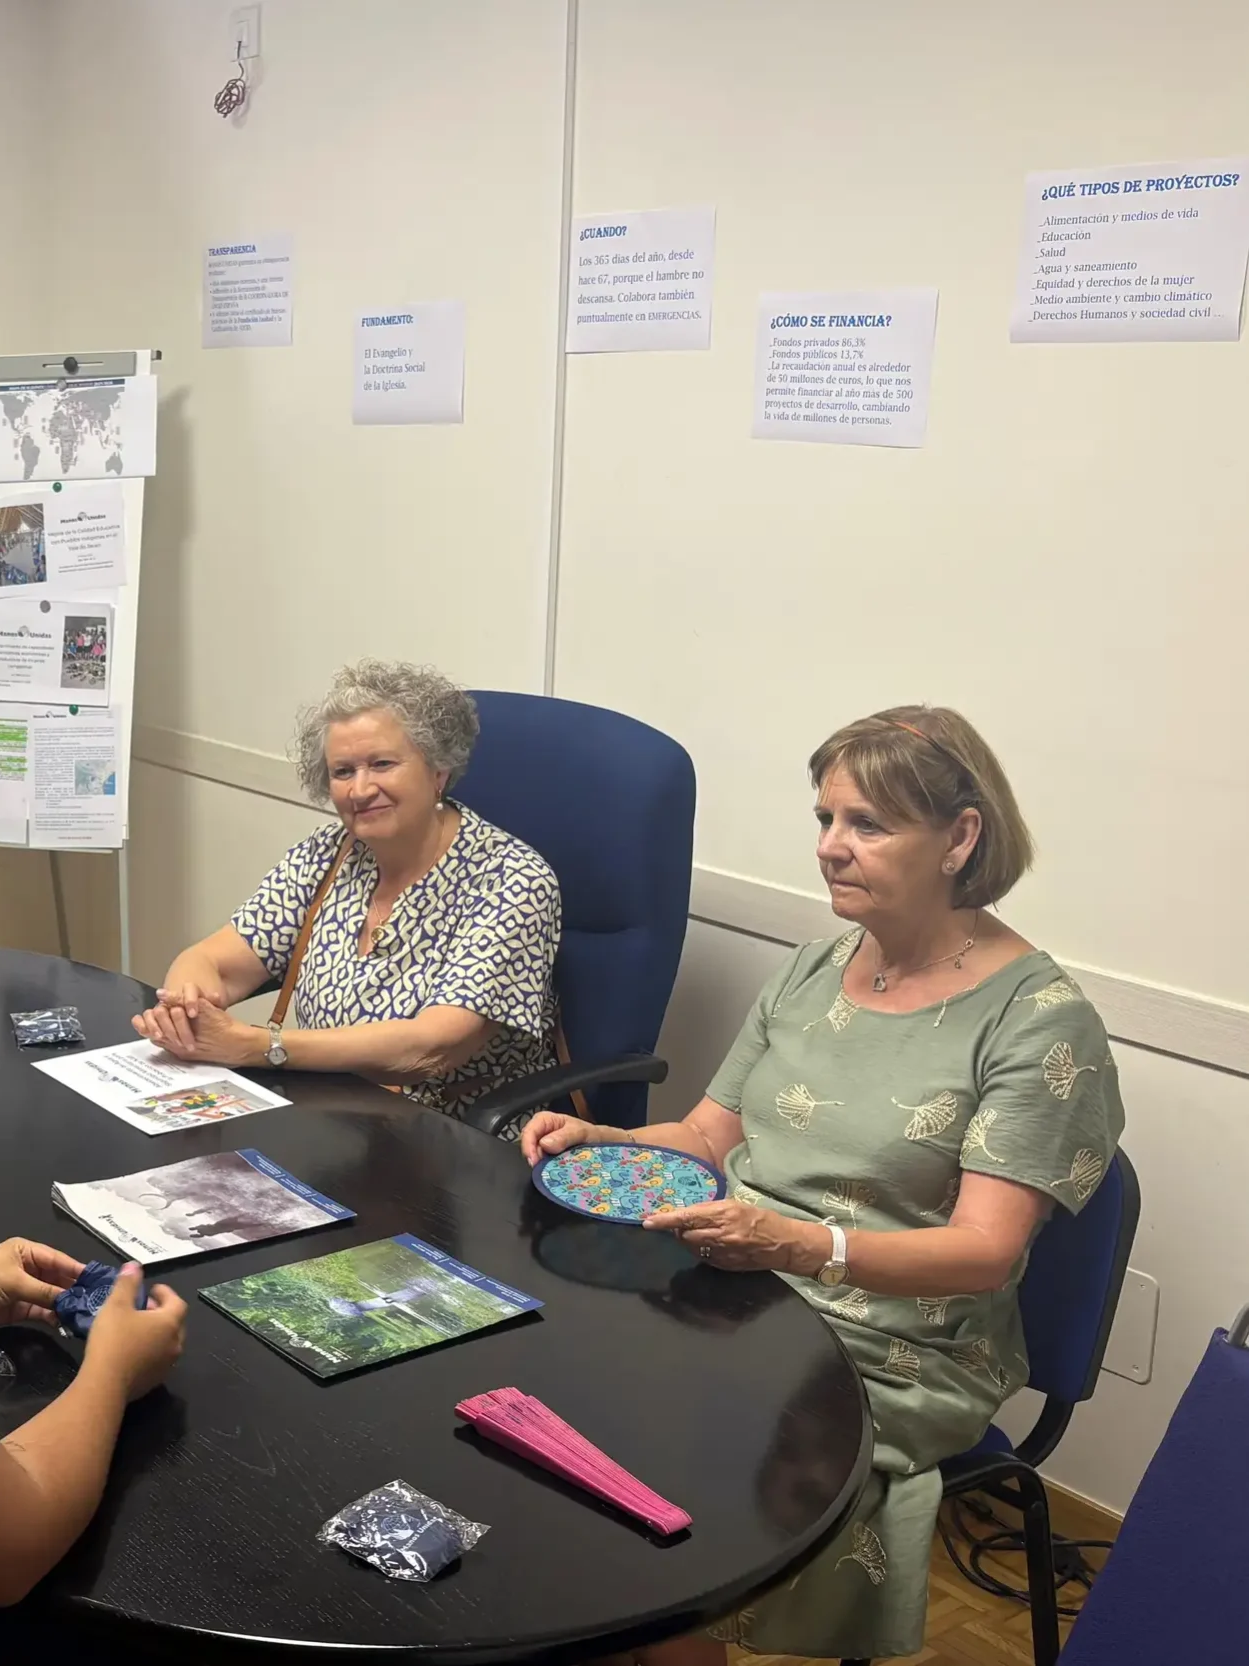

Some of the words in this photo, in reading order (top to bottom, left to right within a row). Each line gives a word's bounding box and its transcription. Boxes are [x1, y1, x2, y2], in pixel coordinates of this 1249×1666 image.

[1041, 182, 1076, 201] ¿QUÉ
[1079, 181, 1120, 196] TIPOS
[1123, 180, 1142, 193] DE
[1145, 174, 1240, 192] PROYECTOS?
[1112, 214, 1119, 224] y
[1121, 210, 1158, 222] medios
[1161, 209, 1174, 220] de
[1177, 207, 1199, 219] vida
[579, 225, 627, 241] ¿CUANDO?
[579, 256, 592, 267] Los
[594, 255, 609, 266] 365
[632, 252, 646, 263] del
[648, 252, 666, 262] año,
[668, 249, 694, 261] desde
[1065, 265, 1071, 274] y
[1073, 261, 1137, 272] saneamiento
[578, 275, 596, 286] hace
[613, 273, 644, 286] porque
[646, 271, 654, 282] el
[656, 269, 690, 281] hambre
[692, 270, 704, 280] no
[1078, 280, 1084, 290] y
[1086, 276, 1132, 287] derechos
[1135, 276, 1148, 285] de
[1150, 275, 1159, 285] la
[1163, 274, 1195, 287] mujer
[577, 293, 615, 305] descansa.
[618, 292, 656, 303] Colabora
[1066, 293, 1112, 304] ambiente
[1115, 295, 1121, 305] y
[1123, 292, 1161, 303] cambio
[577, 312, 633, 325] puntualmente
[635, 313, 646, 321] en
[1080, 309, 1128, 319] Humanos
[1131, 310, 1138, 320] y
[1140, 307, 1186, 318] sociedad
[1189, 307, 1211, 318] civil
[361, 314, 414, 327] FUNDAMENTO:
[770, 313, 808, 329] ¿CÓMO
[810, 315, 826, 327] SE
[828, 315, 892, 327] FINANCIA?
[804, 337, 839, 348] privados
[364, 349, 371, 359] El
[373, 347, 406, 359] Evangelio
[364, 364, 370, 375] la
[372, 364, 403, 375] Doctrina
[405, 361, 426, 373] Social
[832, 362, 856, 372] anual
[857, 364, 867, 372] es
[869, 362, 911, 372] alrededor
[363, 381, 372, 391] de
[373, 380, 380, 391] la
[766, 373, 776, 383] de
[778, 374, 788, 383] 50
[790, 374, 824, 384] millones
[826, 375, 836, 384] de
[838, 377, 863, 386] euros,
[866, 375, 874, 385] lo
[876, 378, 892, 387] que
[895, 378, 911, 386] nos
[766, 388, 796, 397] permite
[798, 387, 833, 397] financiar
[835, 388, 843, 397] al
[845, 389, 860, 397] año
[883, 389, 893, 399] de
[896, 390, 913, 399] 500
[765, 400, 802, 409] proyectos
[804, 400, 814, 409] de
[817, 400, 859, 411] desarrollo,
[862, 401, 910, 412] cambiando
[764, 411, 771, 420] la
[773, 412, 789, 421] vida
[791, 412, 801, 421] de
[803, 413, 837, 423] millones
[839, 413, 849, 423] de
[852, 416, 892, 425] personas.
